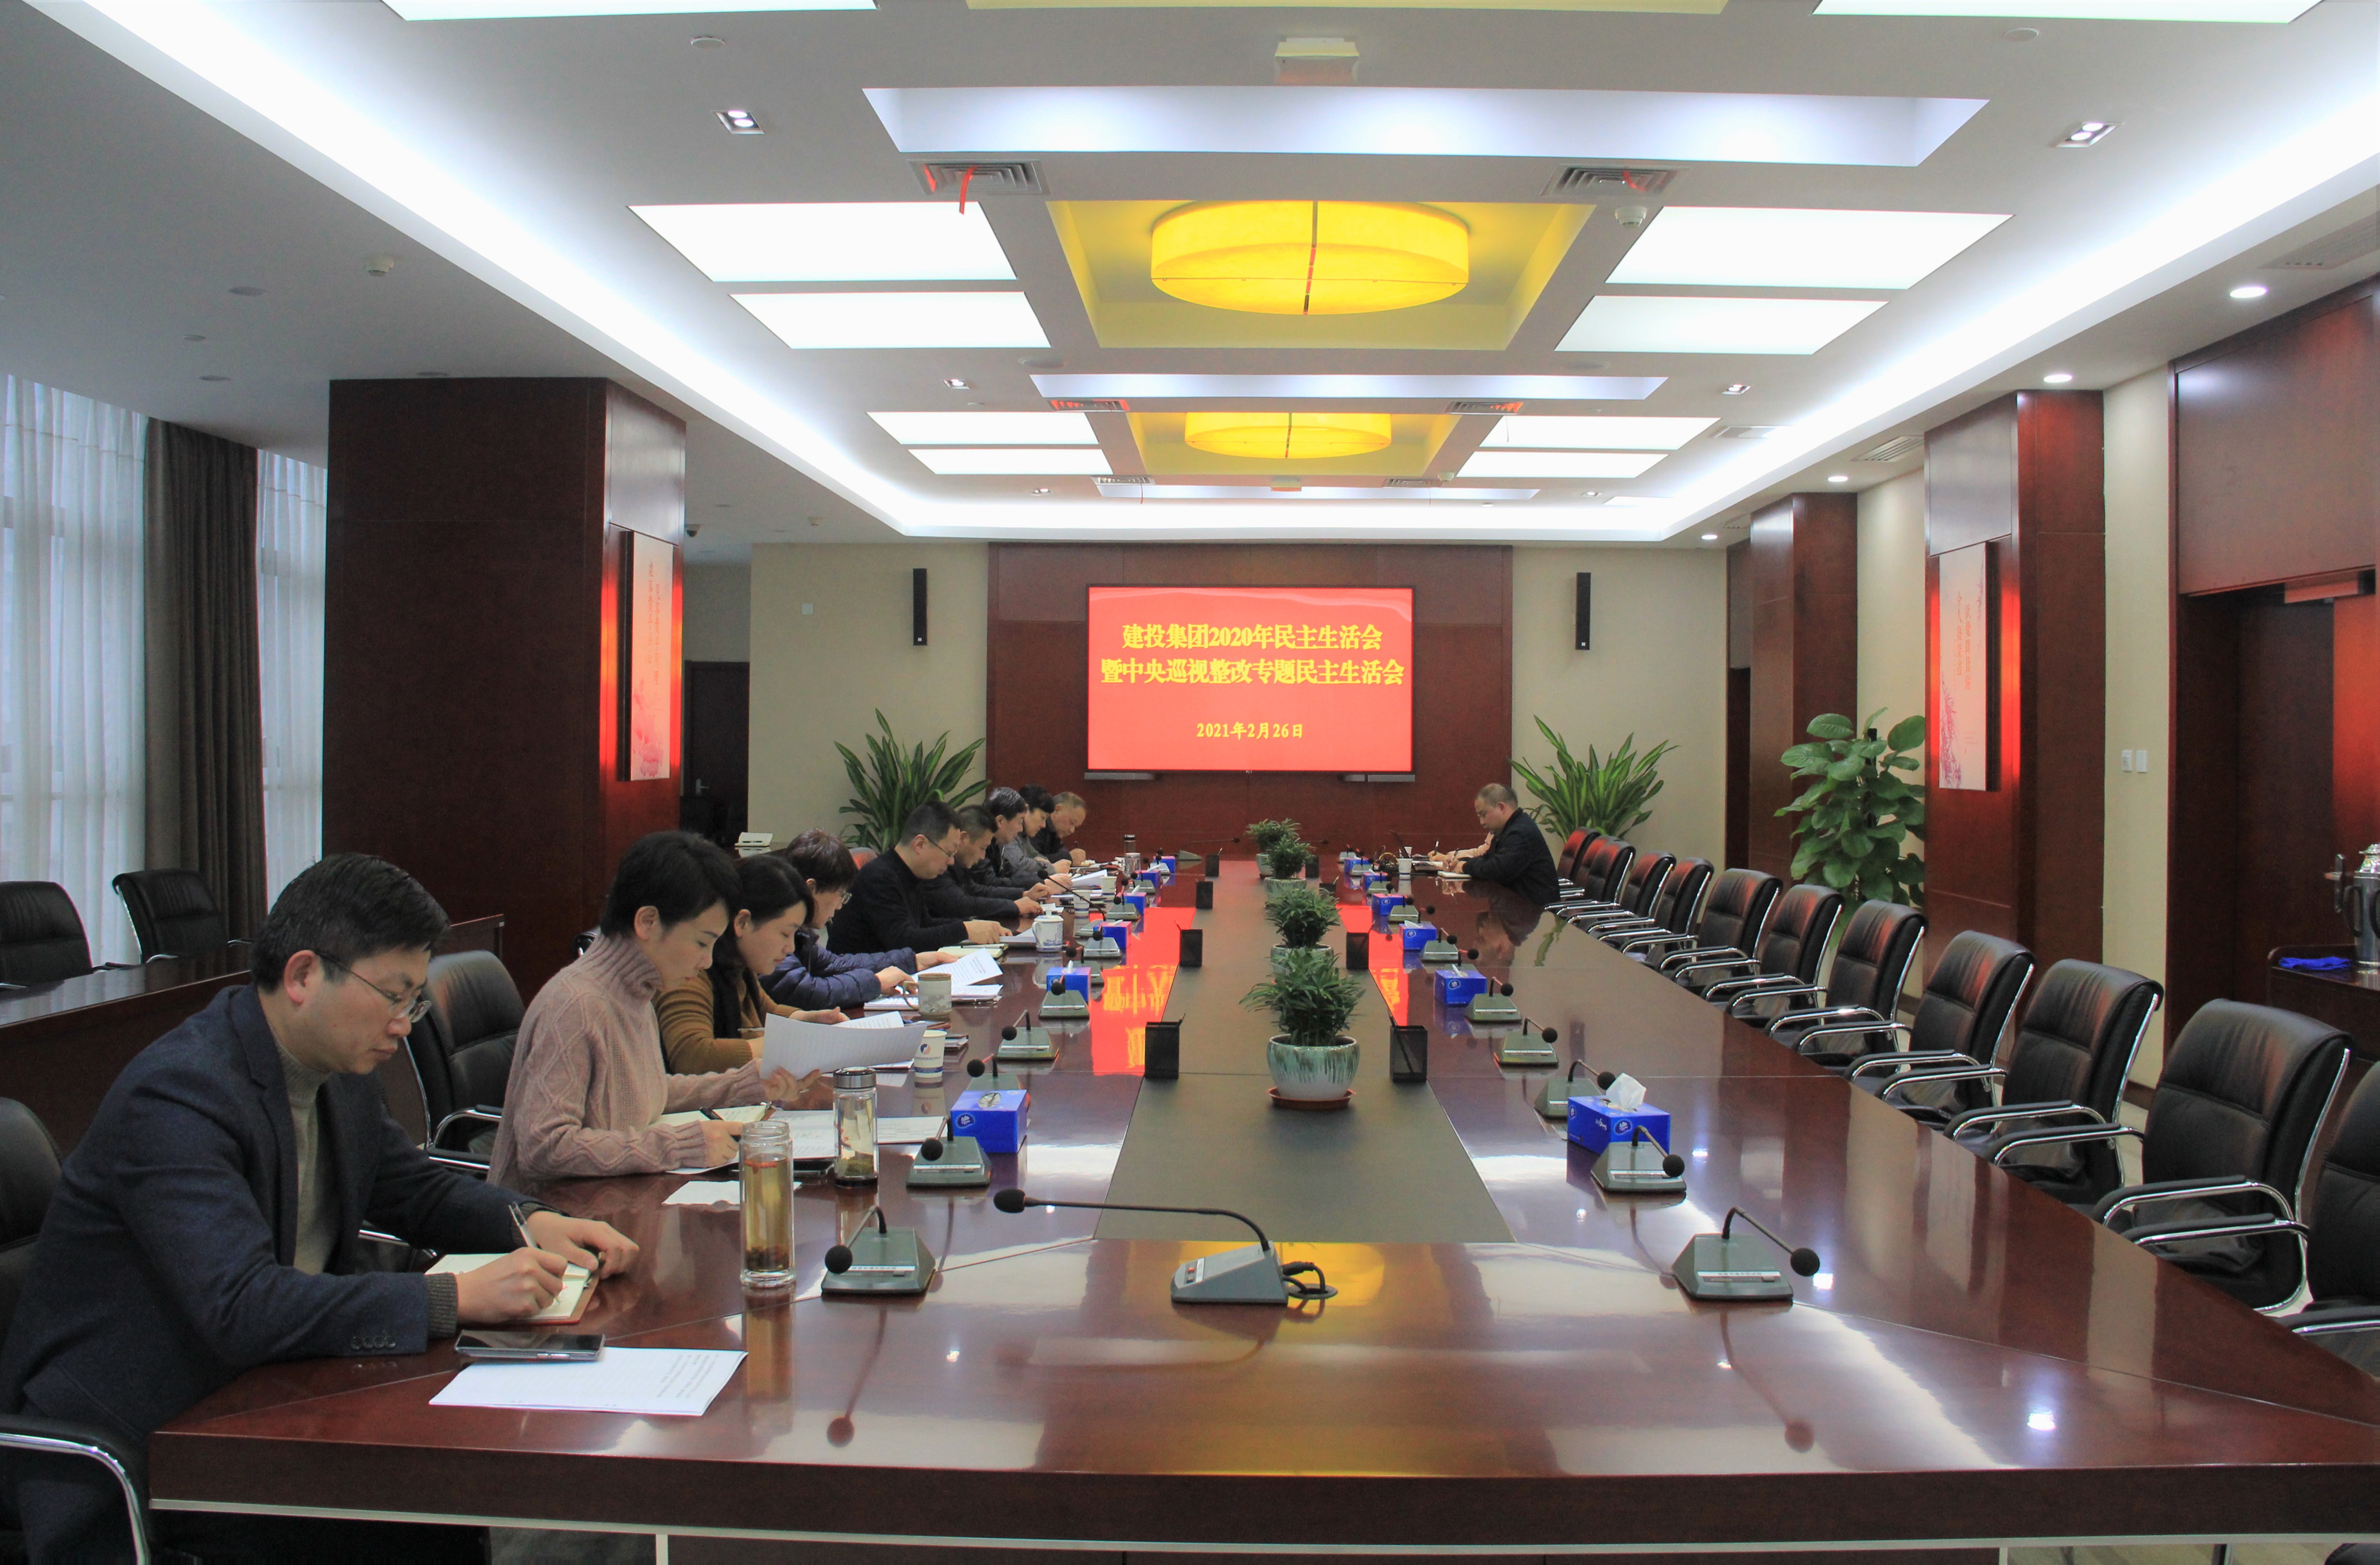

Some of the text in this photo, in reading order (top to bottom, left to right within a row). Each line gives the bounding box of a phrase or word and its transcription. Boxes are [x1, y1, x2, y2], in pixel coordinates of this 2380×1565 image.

[1122, 623, 1383, 650] 建投集团2020年民主生活会
[1101, 657, 1404, 685] 暨中央巡视整改专题民主生活会
[1196, 722, 1303, 740] 2021年2月26日
